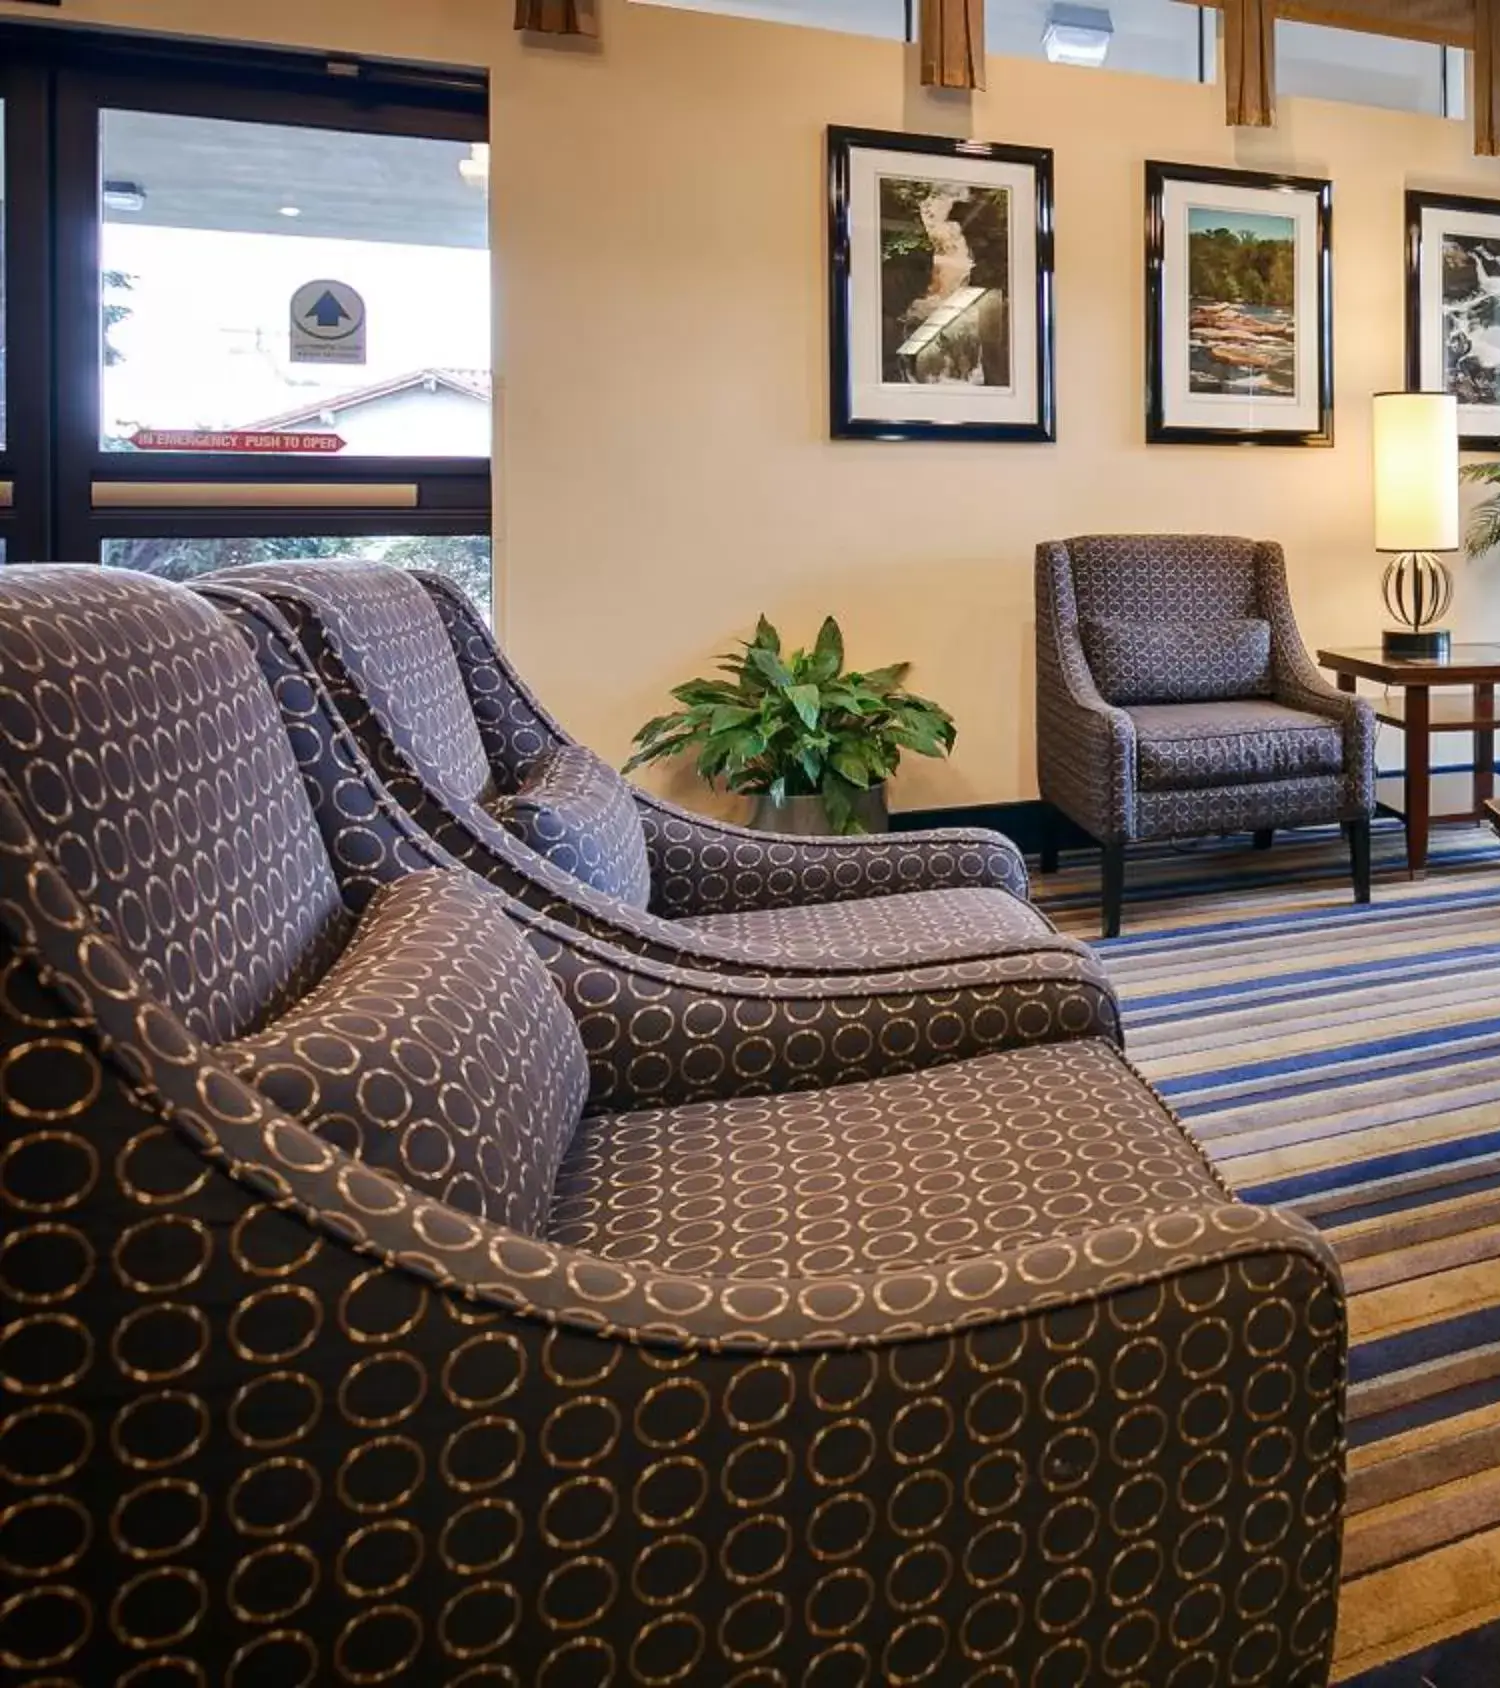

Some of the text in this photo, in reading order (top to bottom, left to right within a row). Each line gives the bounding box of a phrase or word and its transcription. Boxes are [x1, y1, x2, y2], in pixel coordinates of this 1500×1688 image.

[137, 432, 337, 449] IN EMERGENCY PUSH TO OPEN
